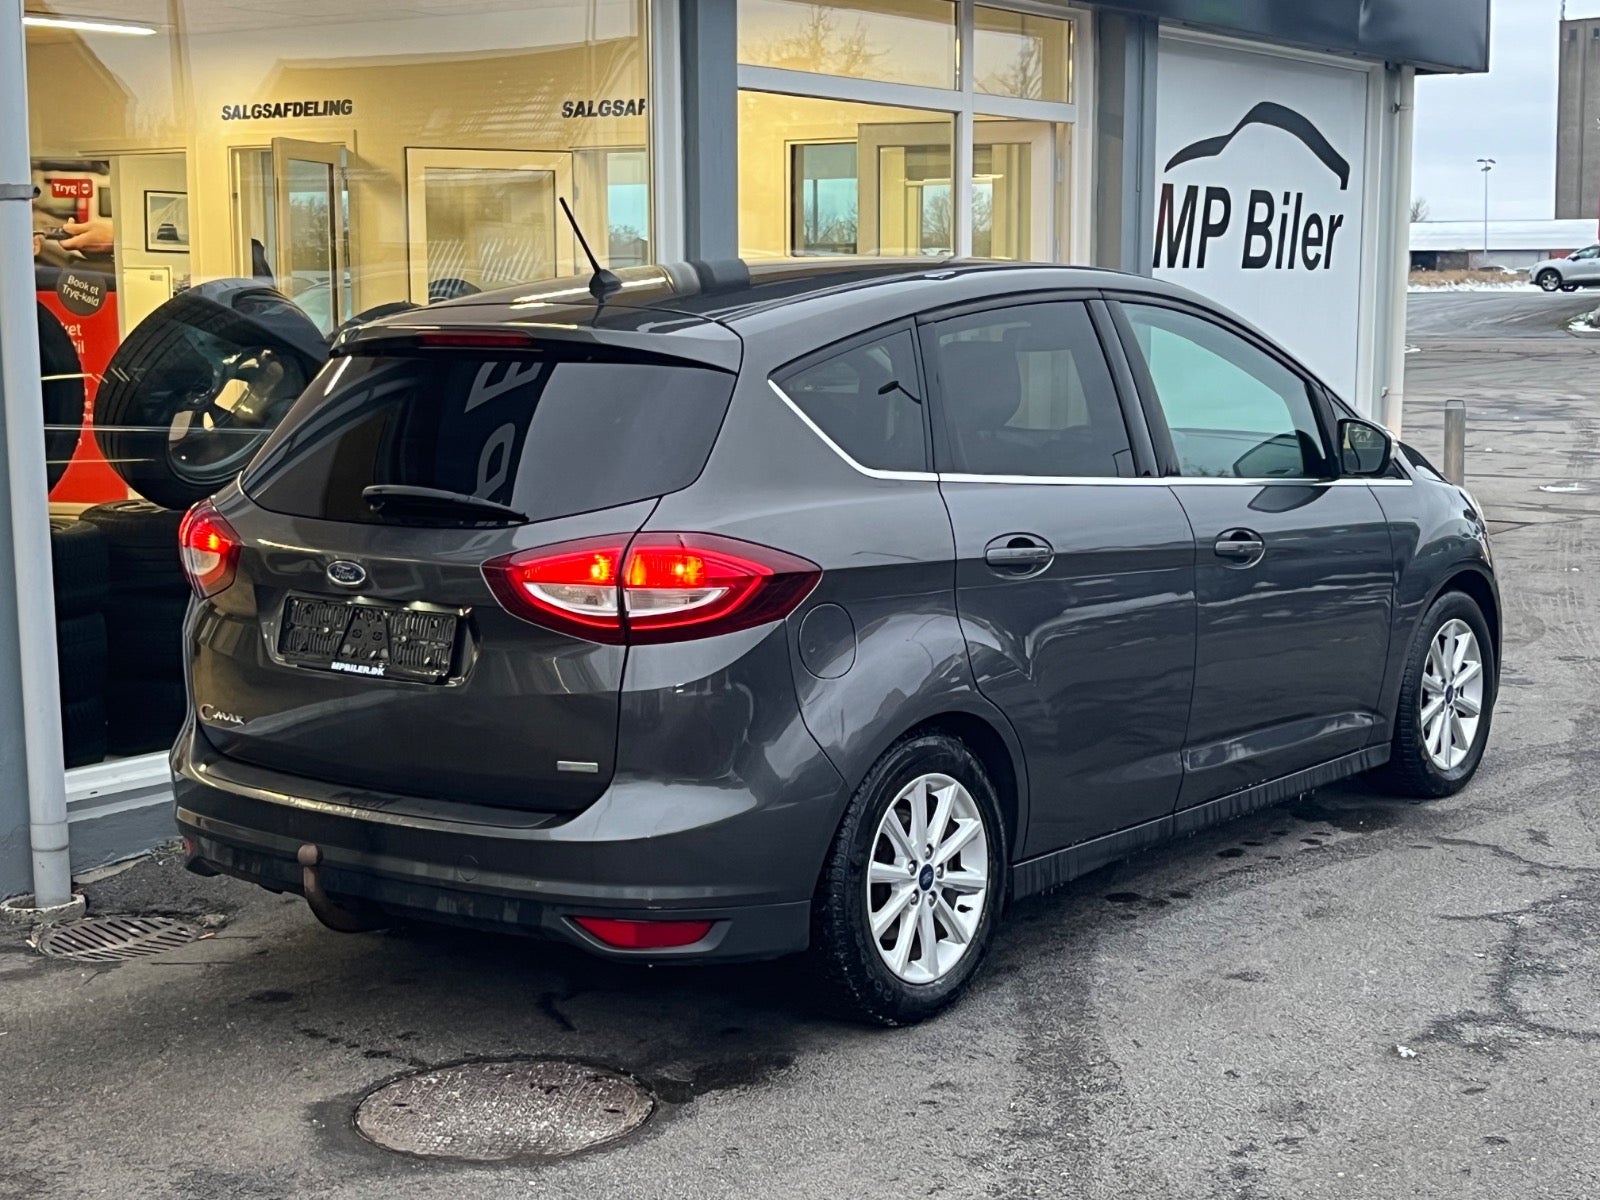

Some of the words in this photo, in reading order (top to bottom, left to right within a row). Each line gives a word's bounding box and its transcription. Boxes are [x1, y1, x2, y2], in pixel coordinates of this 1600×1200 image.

[221, 99, 353, 120] SALGSAFDELING
[53, 183, 77, 195] Tryg
[1153, 183, 1231, 269] MP
[1241, 189, 1344, 271] Biler
[67, 274, 89, 292] Book
[90, 285, 99, 296] et
